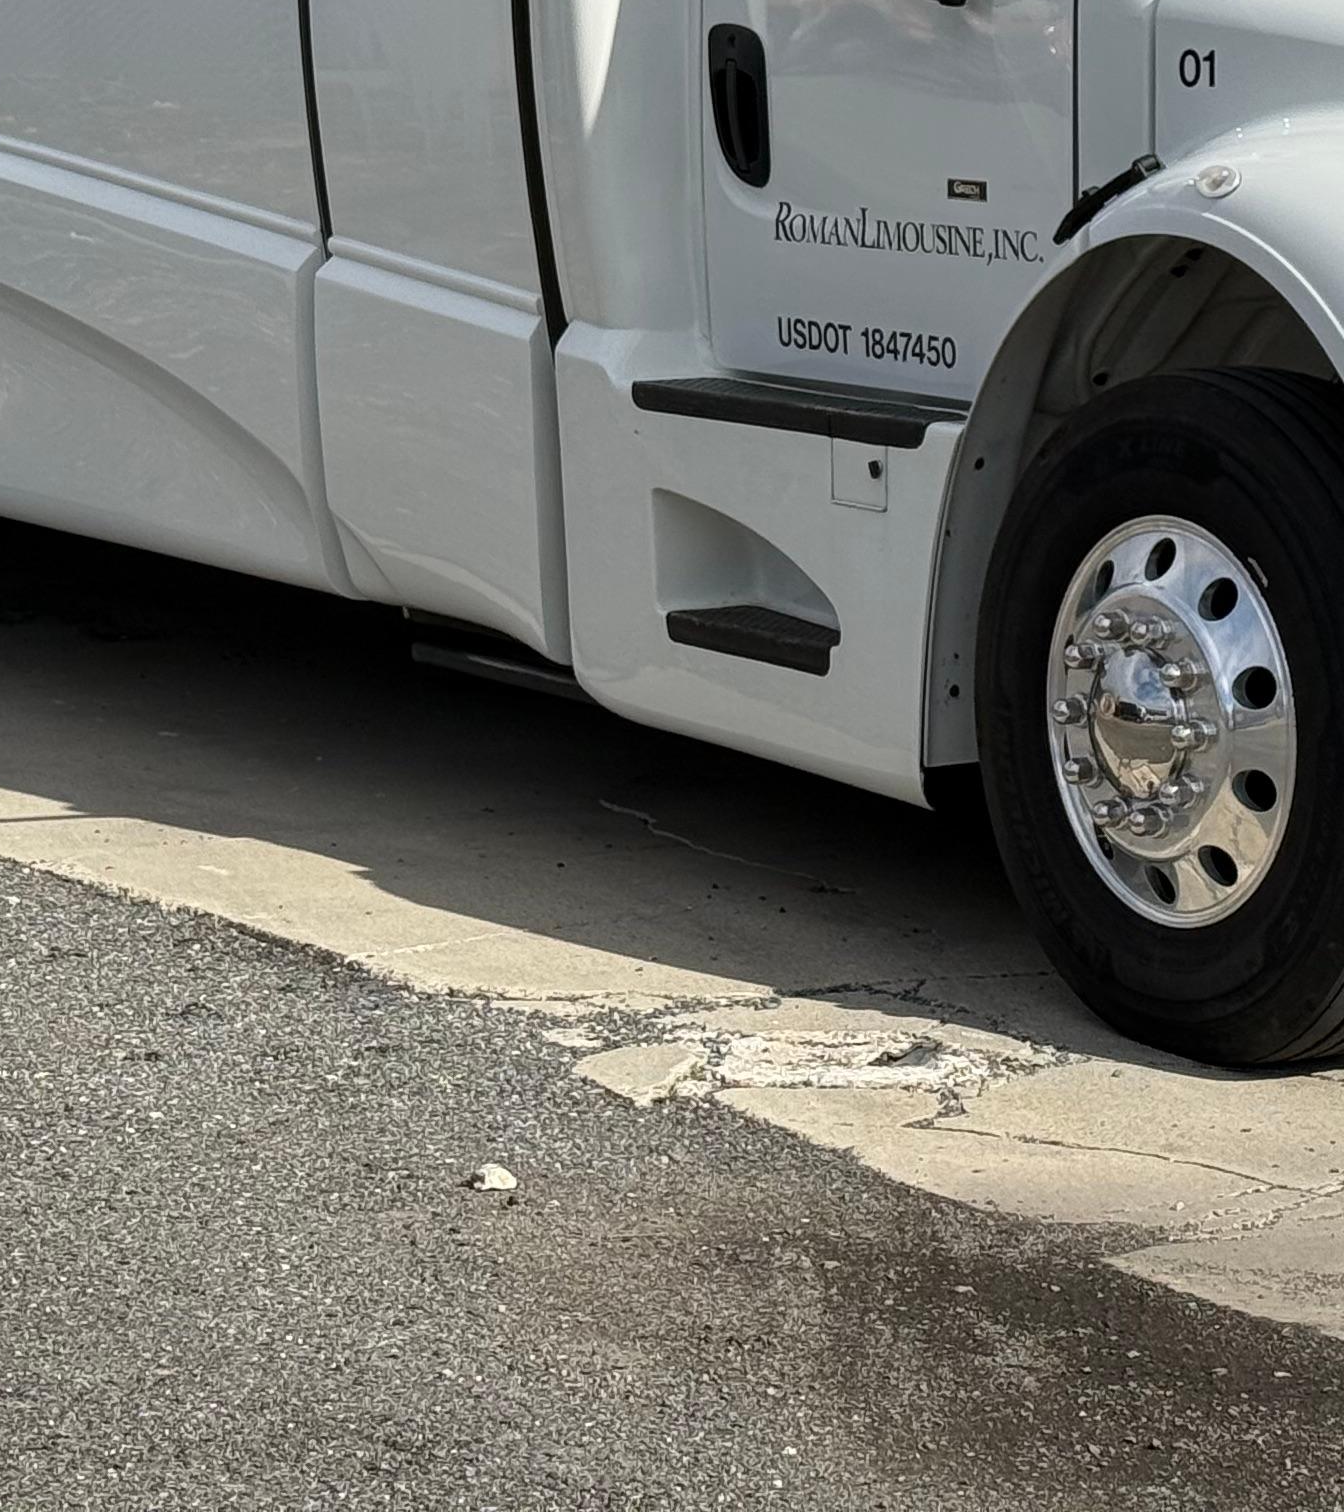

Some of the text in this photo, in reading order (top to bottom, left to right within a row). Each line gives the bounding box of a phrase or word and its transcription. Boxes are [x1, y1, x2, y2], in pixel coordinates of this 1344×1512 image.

[1179, 48, 1216, 88] 01
[778, 316, 956, 369] USDOT 1847450
